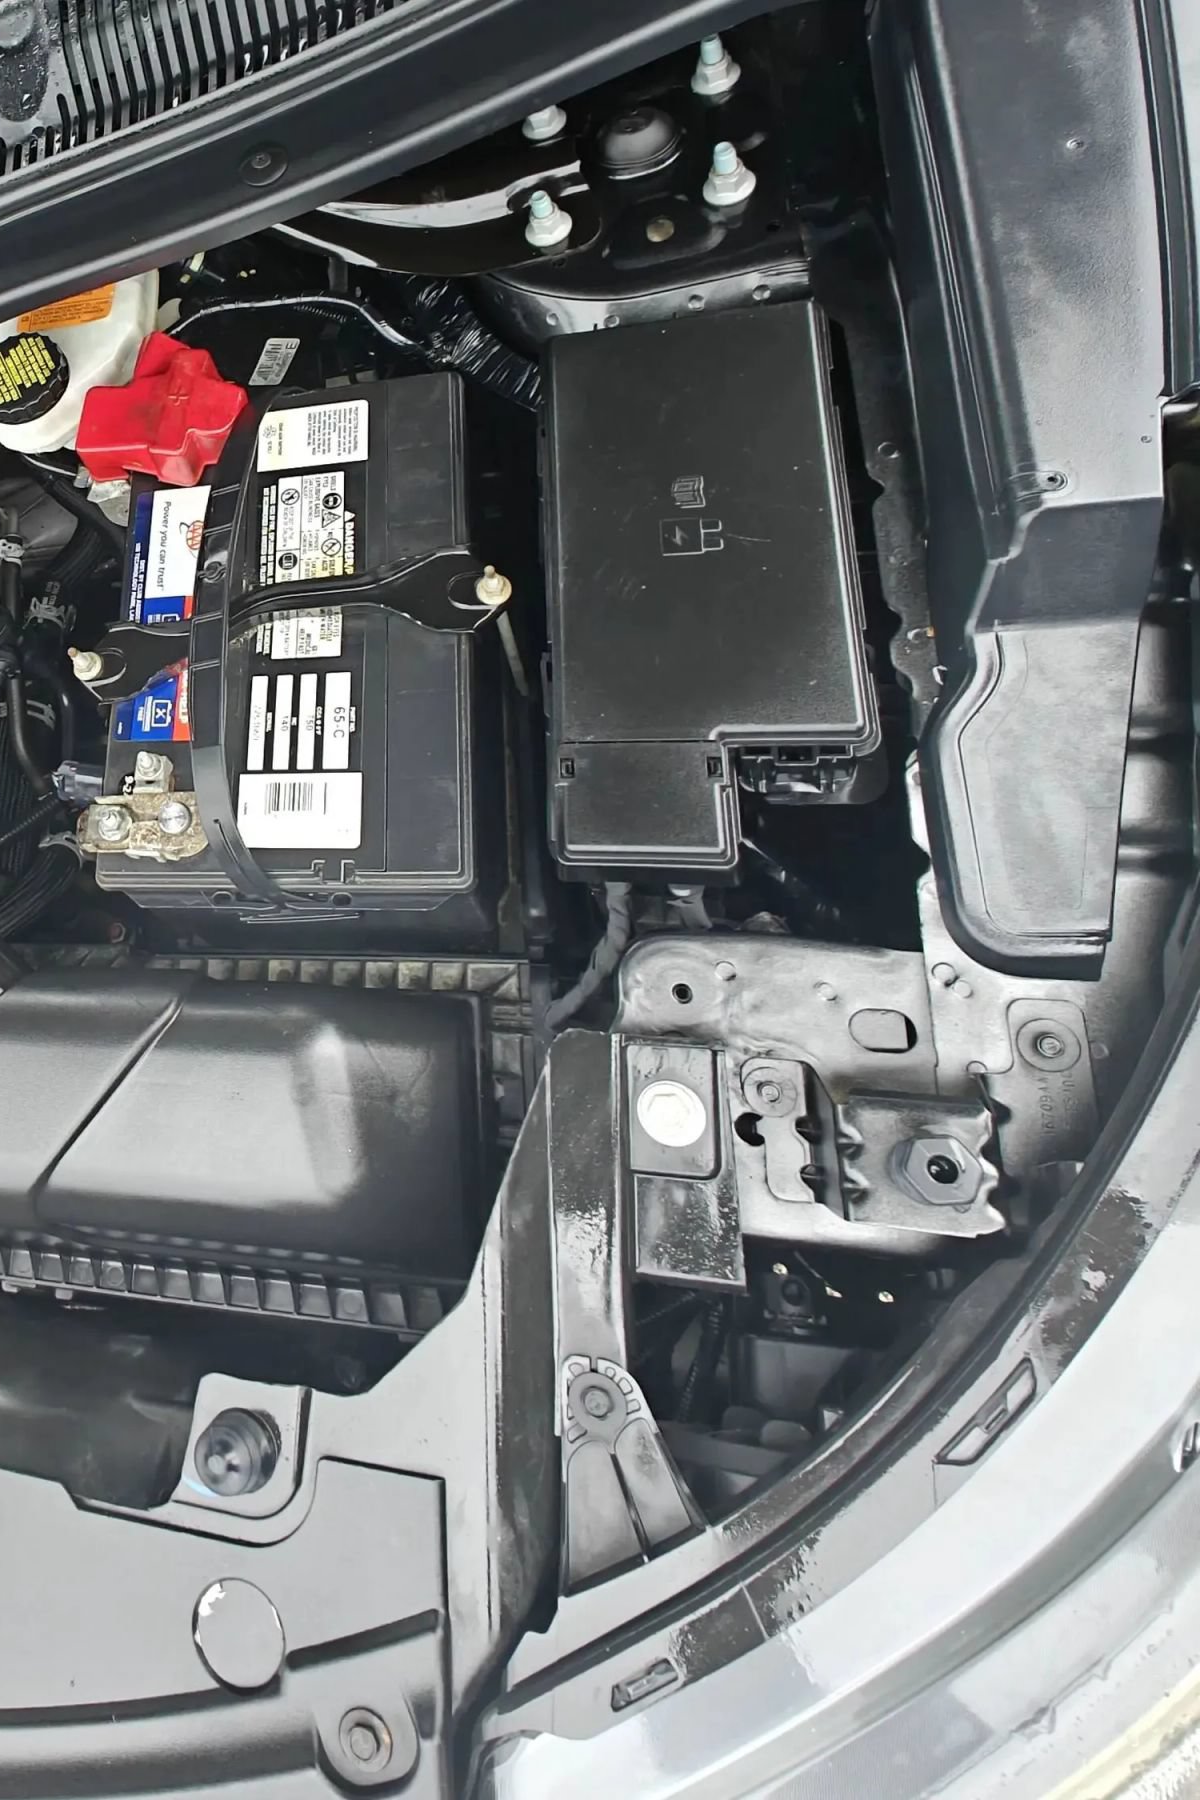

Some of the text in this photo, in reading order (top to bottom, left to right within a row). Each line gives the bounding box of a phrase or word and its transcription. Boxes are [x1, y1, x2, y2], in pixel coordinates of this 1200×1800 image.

[161, 501, 172, 528] Power
[159, 530, 169, 548] you
[186, 524, 202, 548] AAA
[158, 550, 166, 564] can
[333, 706, 346, 738] 65-C
